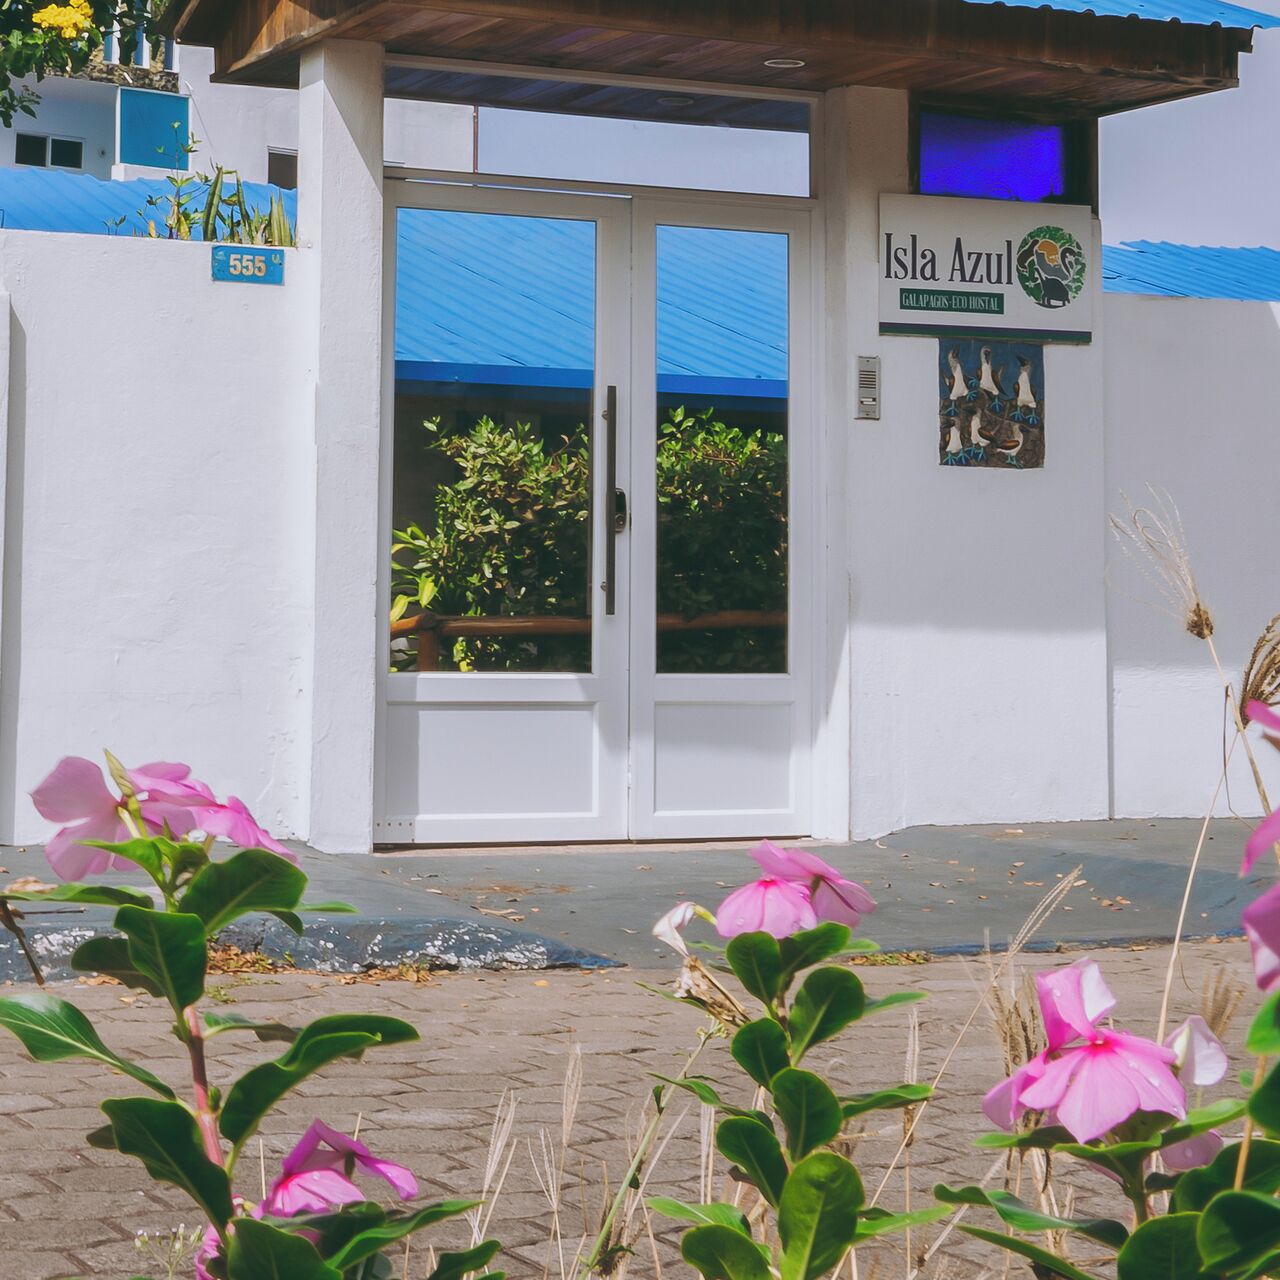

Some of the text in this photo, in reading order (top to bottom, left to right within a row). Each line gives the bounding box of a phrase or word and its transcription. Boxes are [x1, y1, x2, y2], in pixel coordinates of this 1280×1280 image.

[229, 254, 266, 276] 555
[885, 233, 1013, 285] Isla Azul
[969, 296, 1000, 311] HOSTAL
